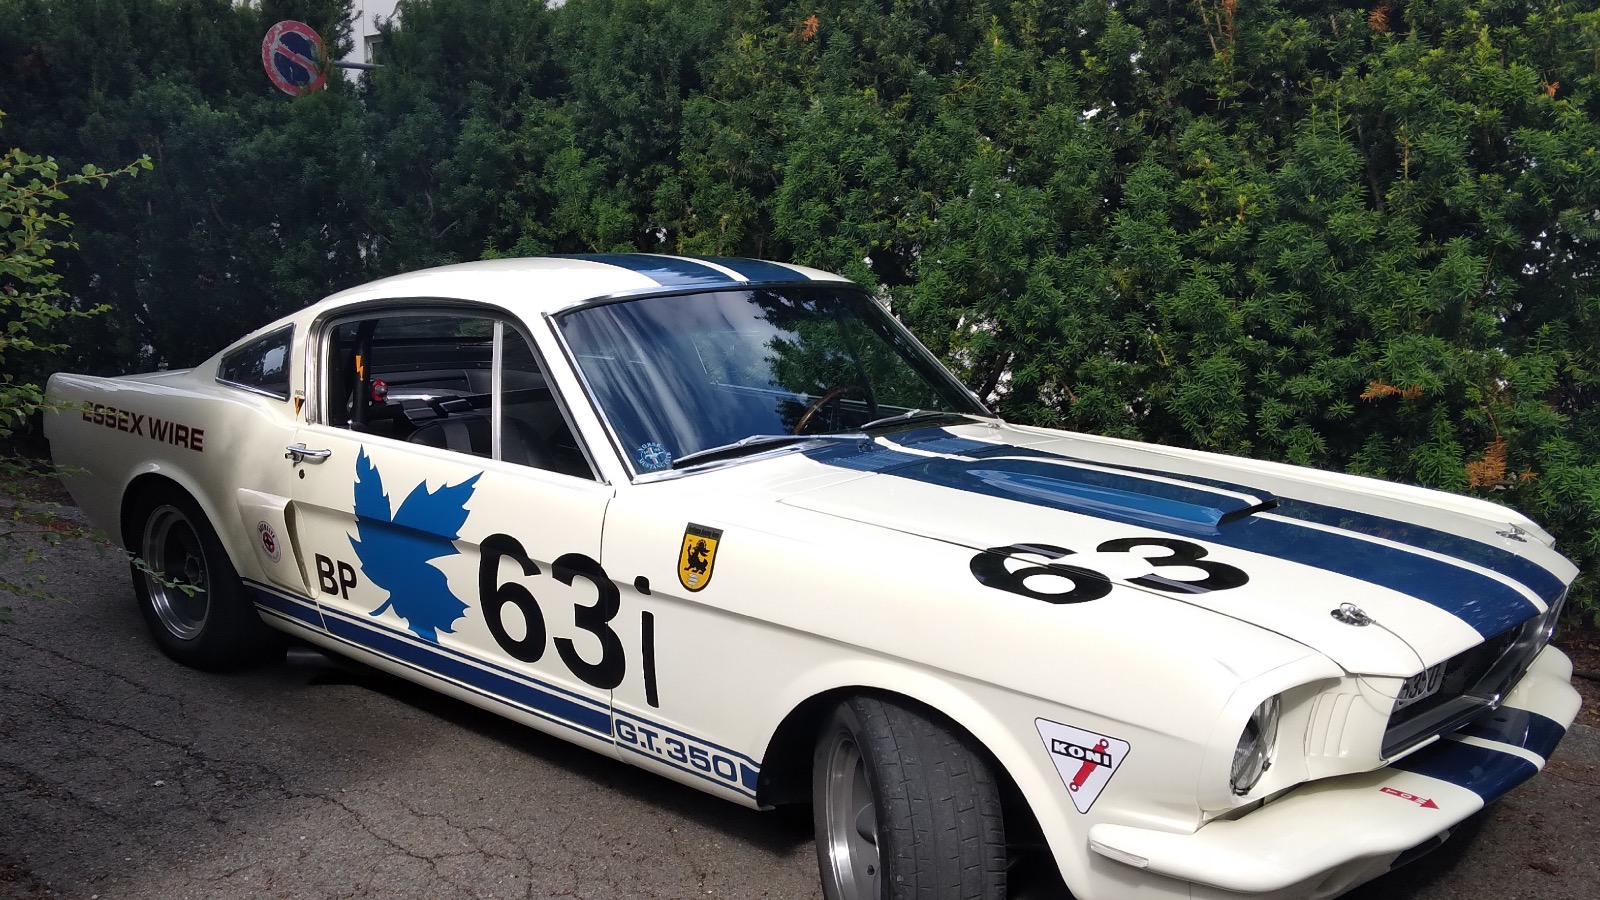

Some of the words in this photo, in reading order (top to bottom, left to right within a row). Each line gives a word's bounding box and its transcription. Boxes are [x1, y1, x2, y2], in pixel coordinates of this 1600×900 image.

[82, 401, 144, 437] ESSEX
[148, 416, 204, 452] WIRE
[637, 442, 662, 451] NORSK
[638, 458, 666, 469] MUSTANG
[315, 553, 357, 600] BP
[969, 537, 1249, 604] 63
[1053, 740, 1110, 766] KONI
